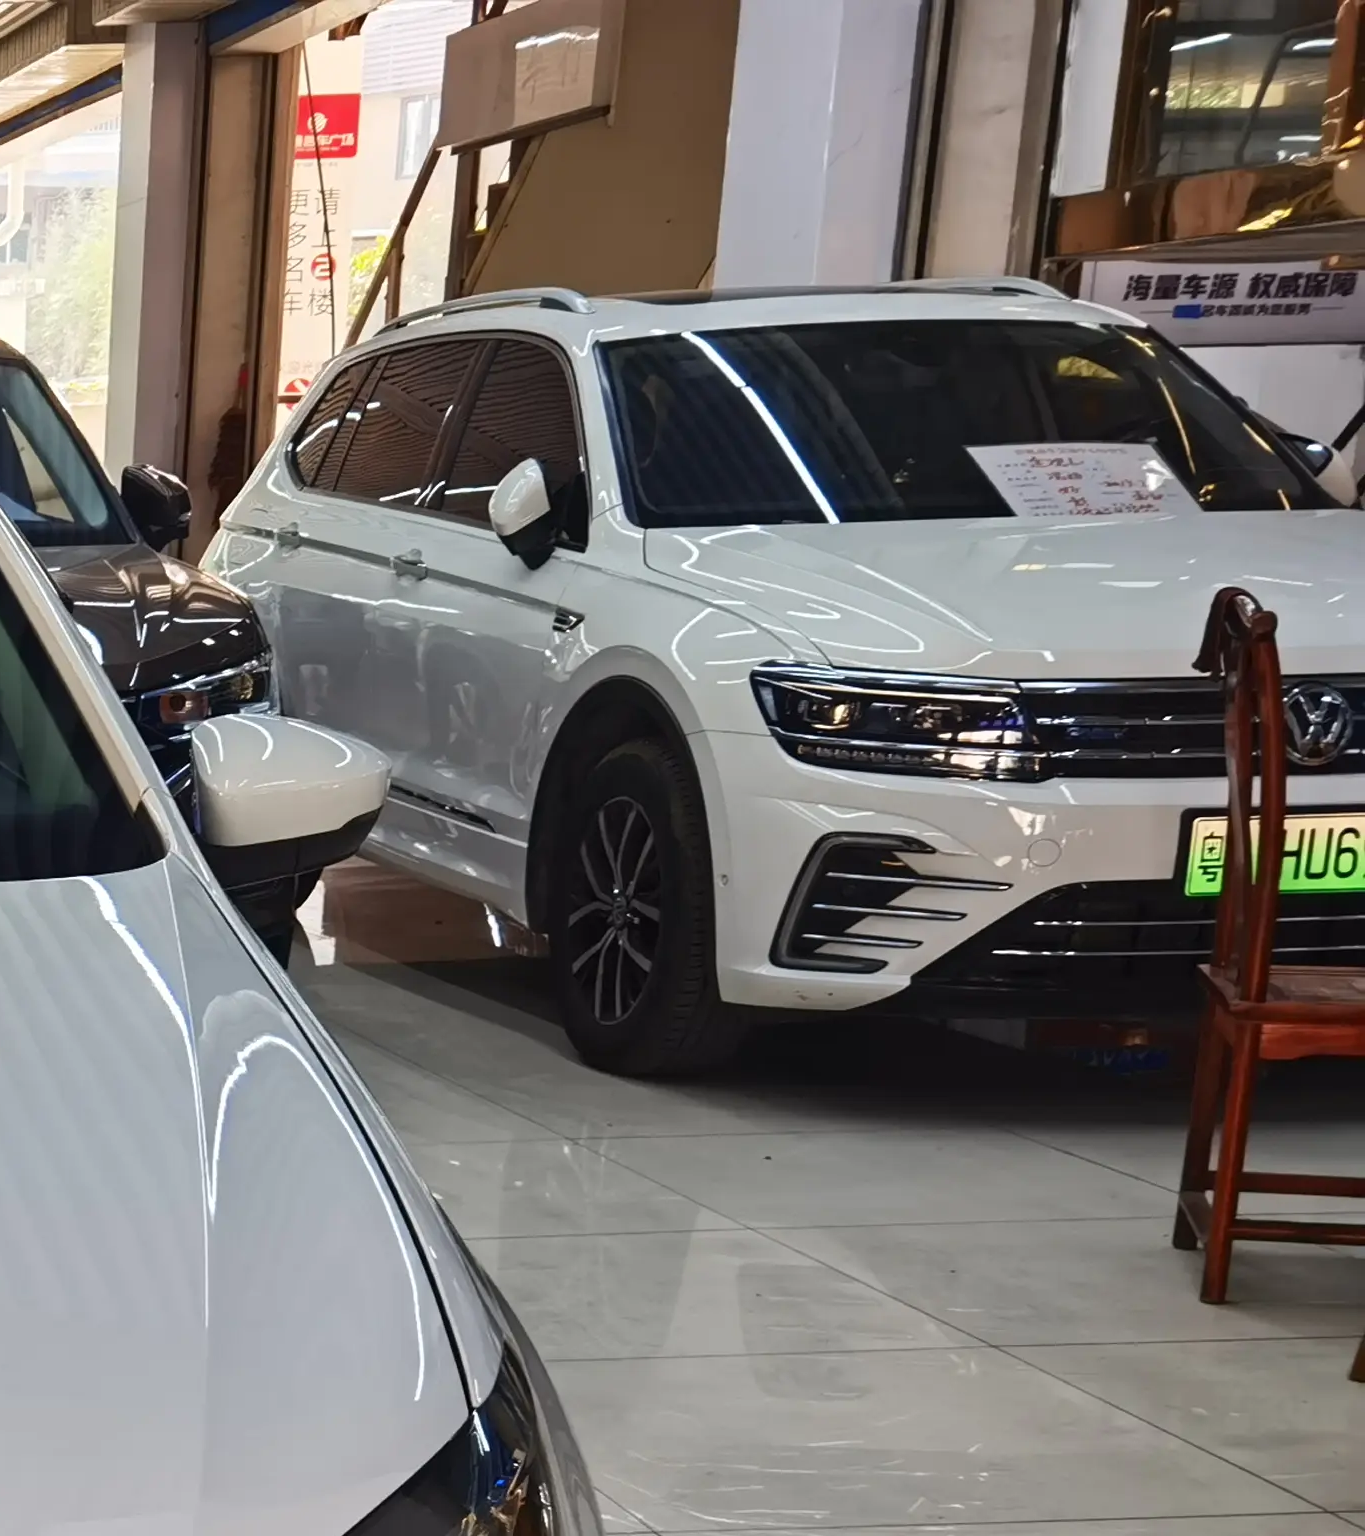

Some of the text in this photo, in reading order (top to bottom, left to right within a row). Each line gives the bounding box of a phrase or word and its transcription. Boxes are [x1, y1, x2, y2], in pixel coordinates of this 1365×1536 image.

[1123, 271, 1359, 301] 海量车源 权威保障
